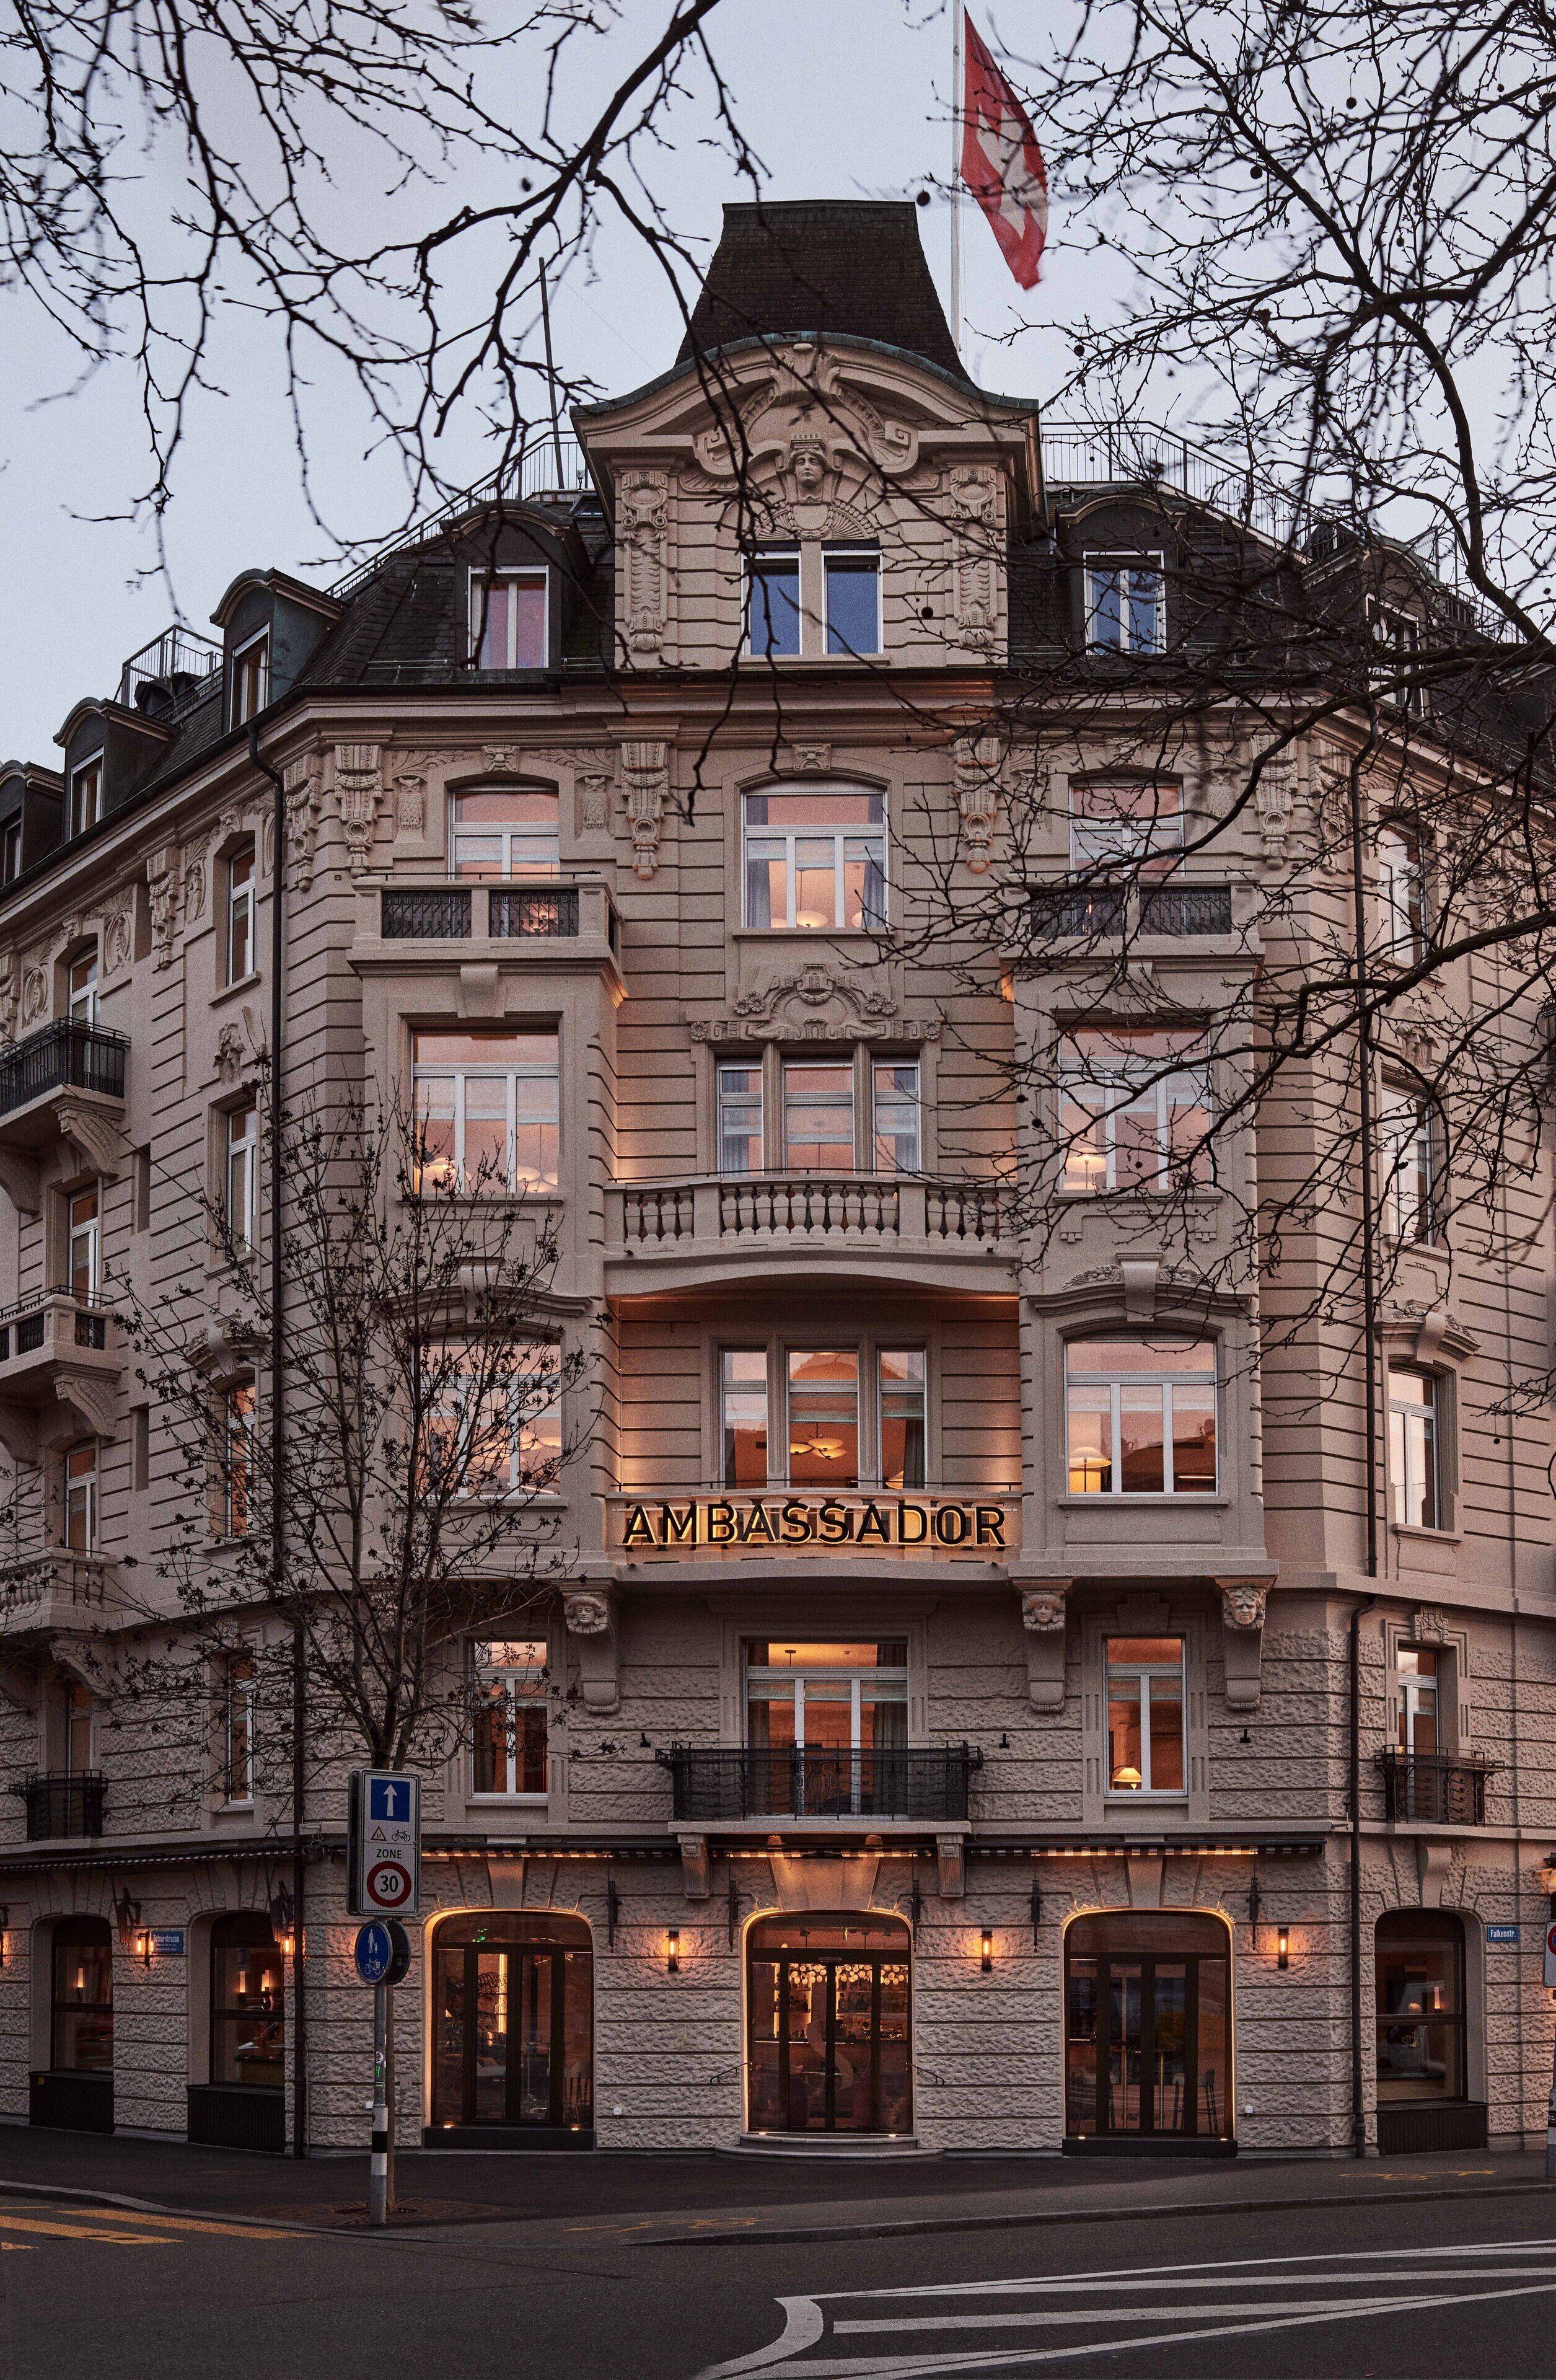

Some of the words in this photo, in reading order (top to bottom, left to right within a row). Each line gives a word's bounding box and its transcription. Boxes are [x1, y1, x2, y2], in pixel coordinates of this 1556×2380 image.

[622, 1503, 1005, 1546] AMBASSADOR
[376, 1849, 402, 1859] ZONE
[380, 1875, 398, 1892] 30
[1490, 1929, 1516, 1937] Falkenstr.
